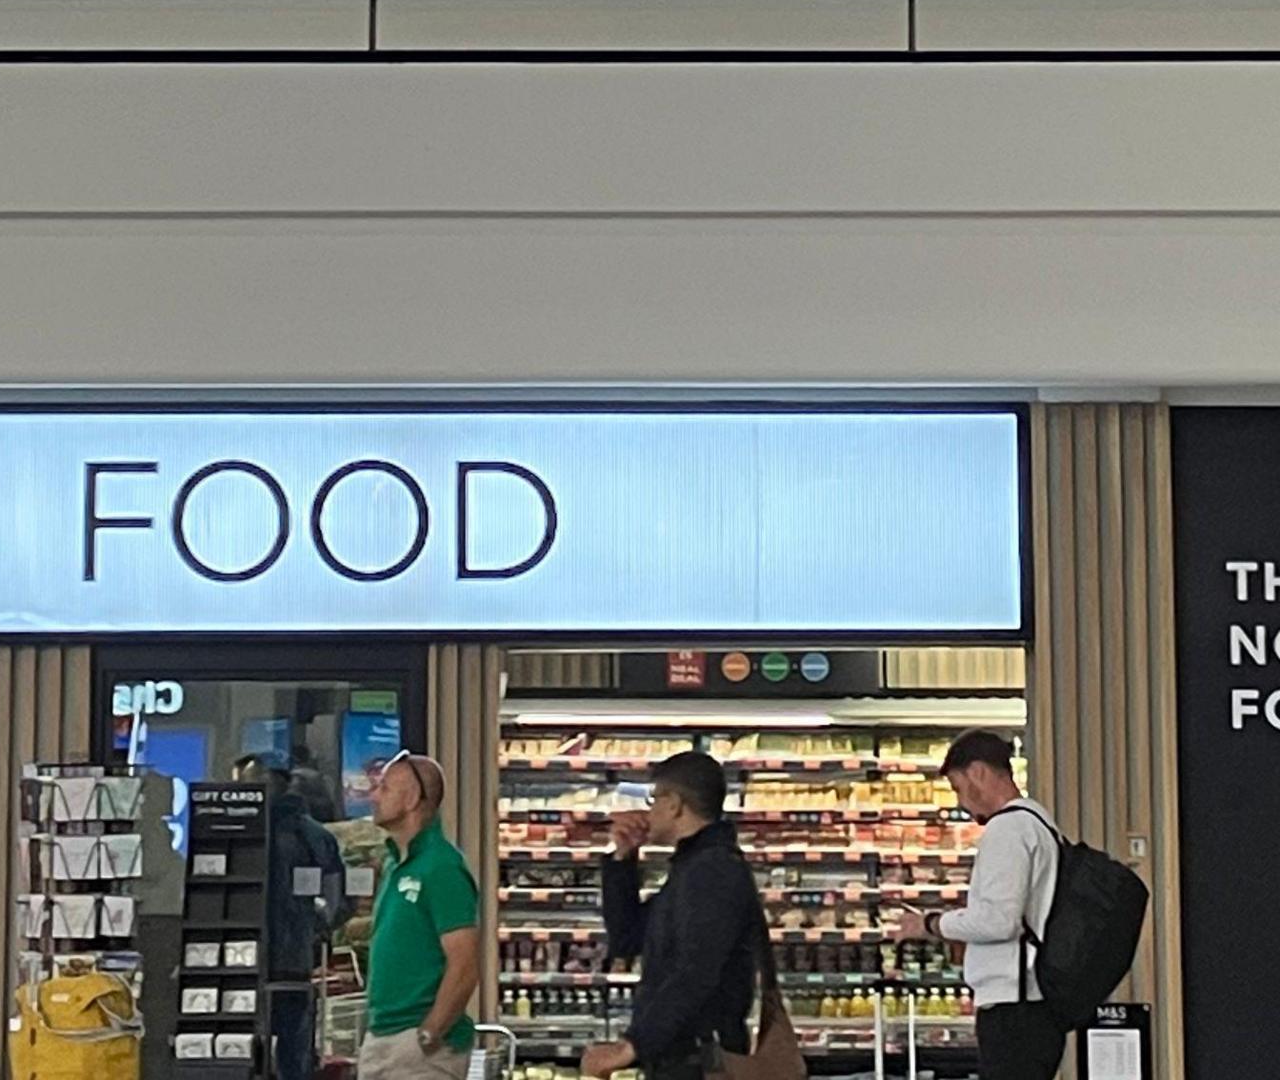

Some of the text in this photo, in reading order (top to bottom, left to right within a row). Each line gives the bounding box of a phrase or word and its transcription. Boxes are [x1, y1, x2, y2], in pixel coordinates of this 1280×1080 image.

[83, 459, 559, 583] FOOD
[191, 791, 264, 802] GIFT CARDS
